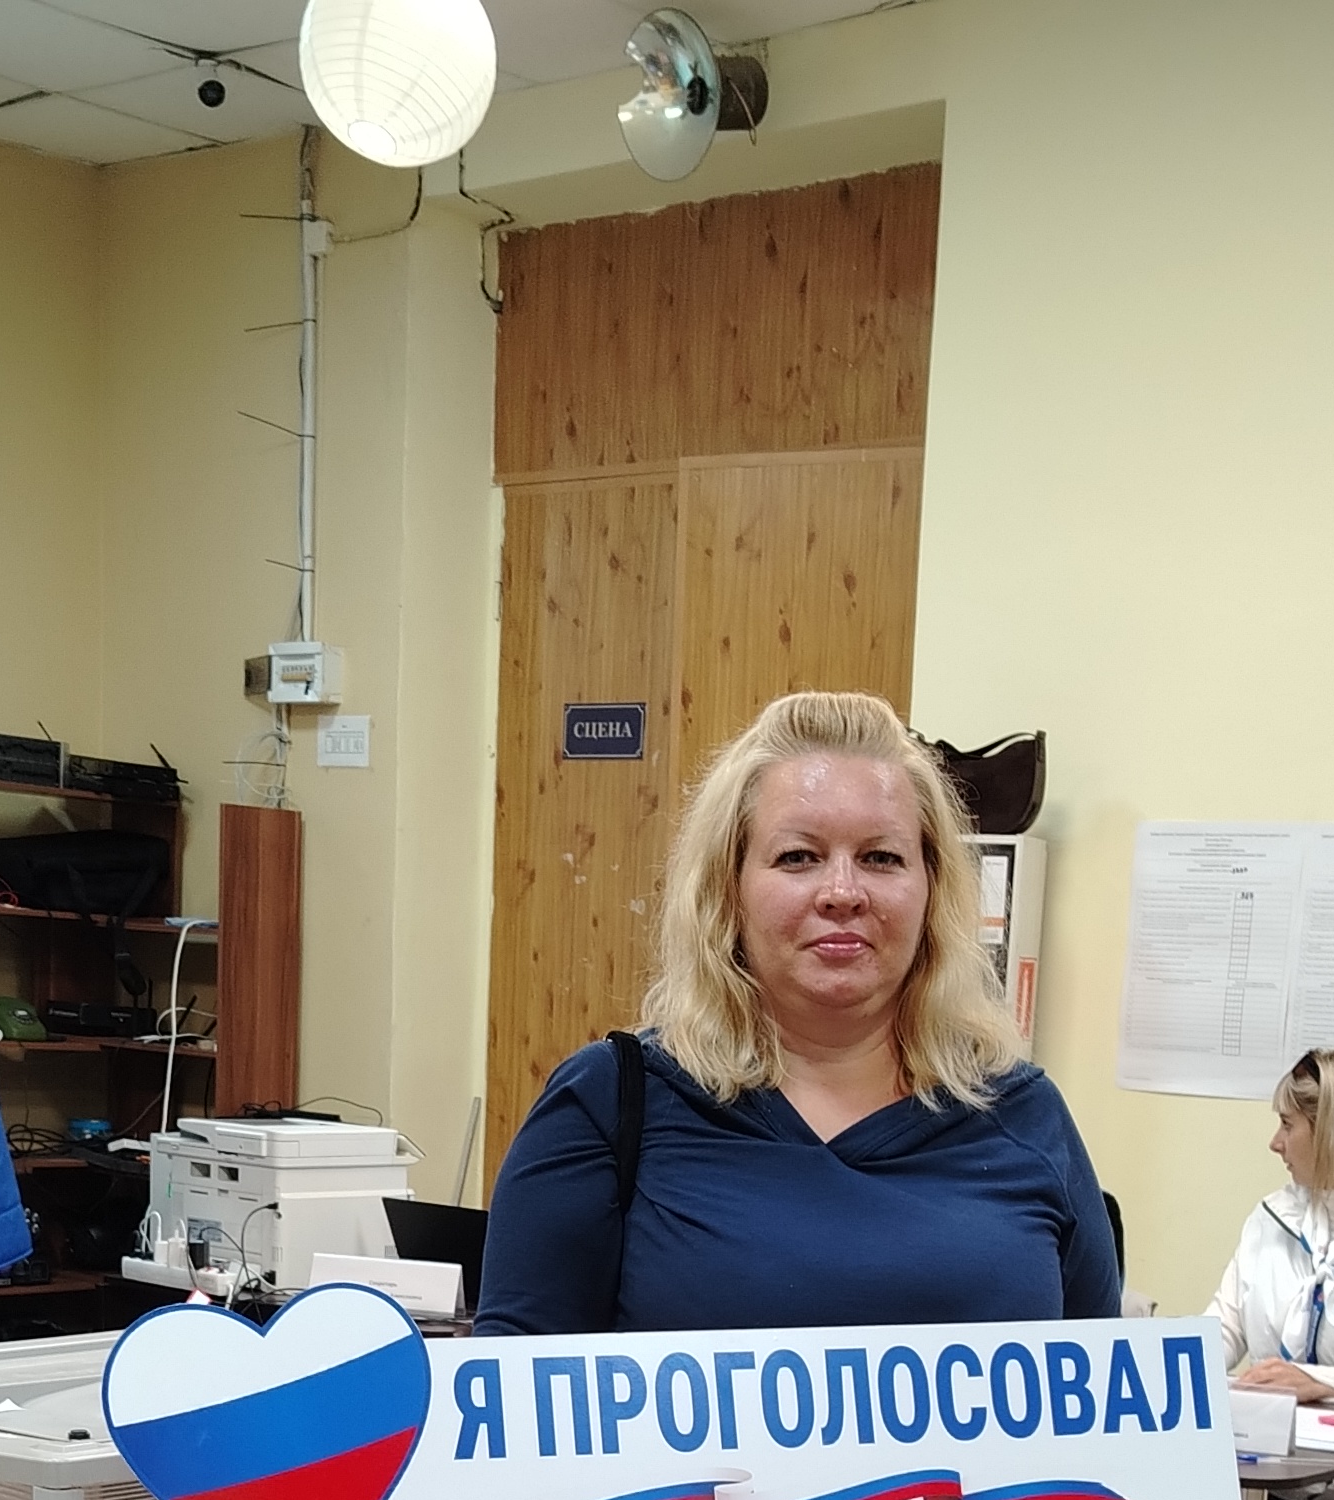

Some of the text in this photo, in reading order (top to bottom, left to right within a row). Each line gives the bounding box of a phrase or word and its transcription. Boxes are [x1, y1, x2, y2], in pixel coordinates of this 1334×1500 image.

[573, 721, 633, 739] СЦЕНА
[453, 1335, 1212, 1461] Я ПРОГОЛОСОВАЛ
